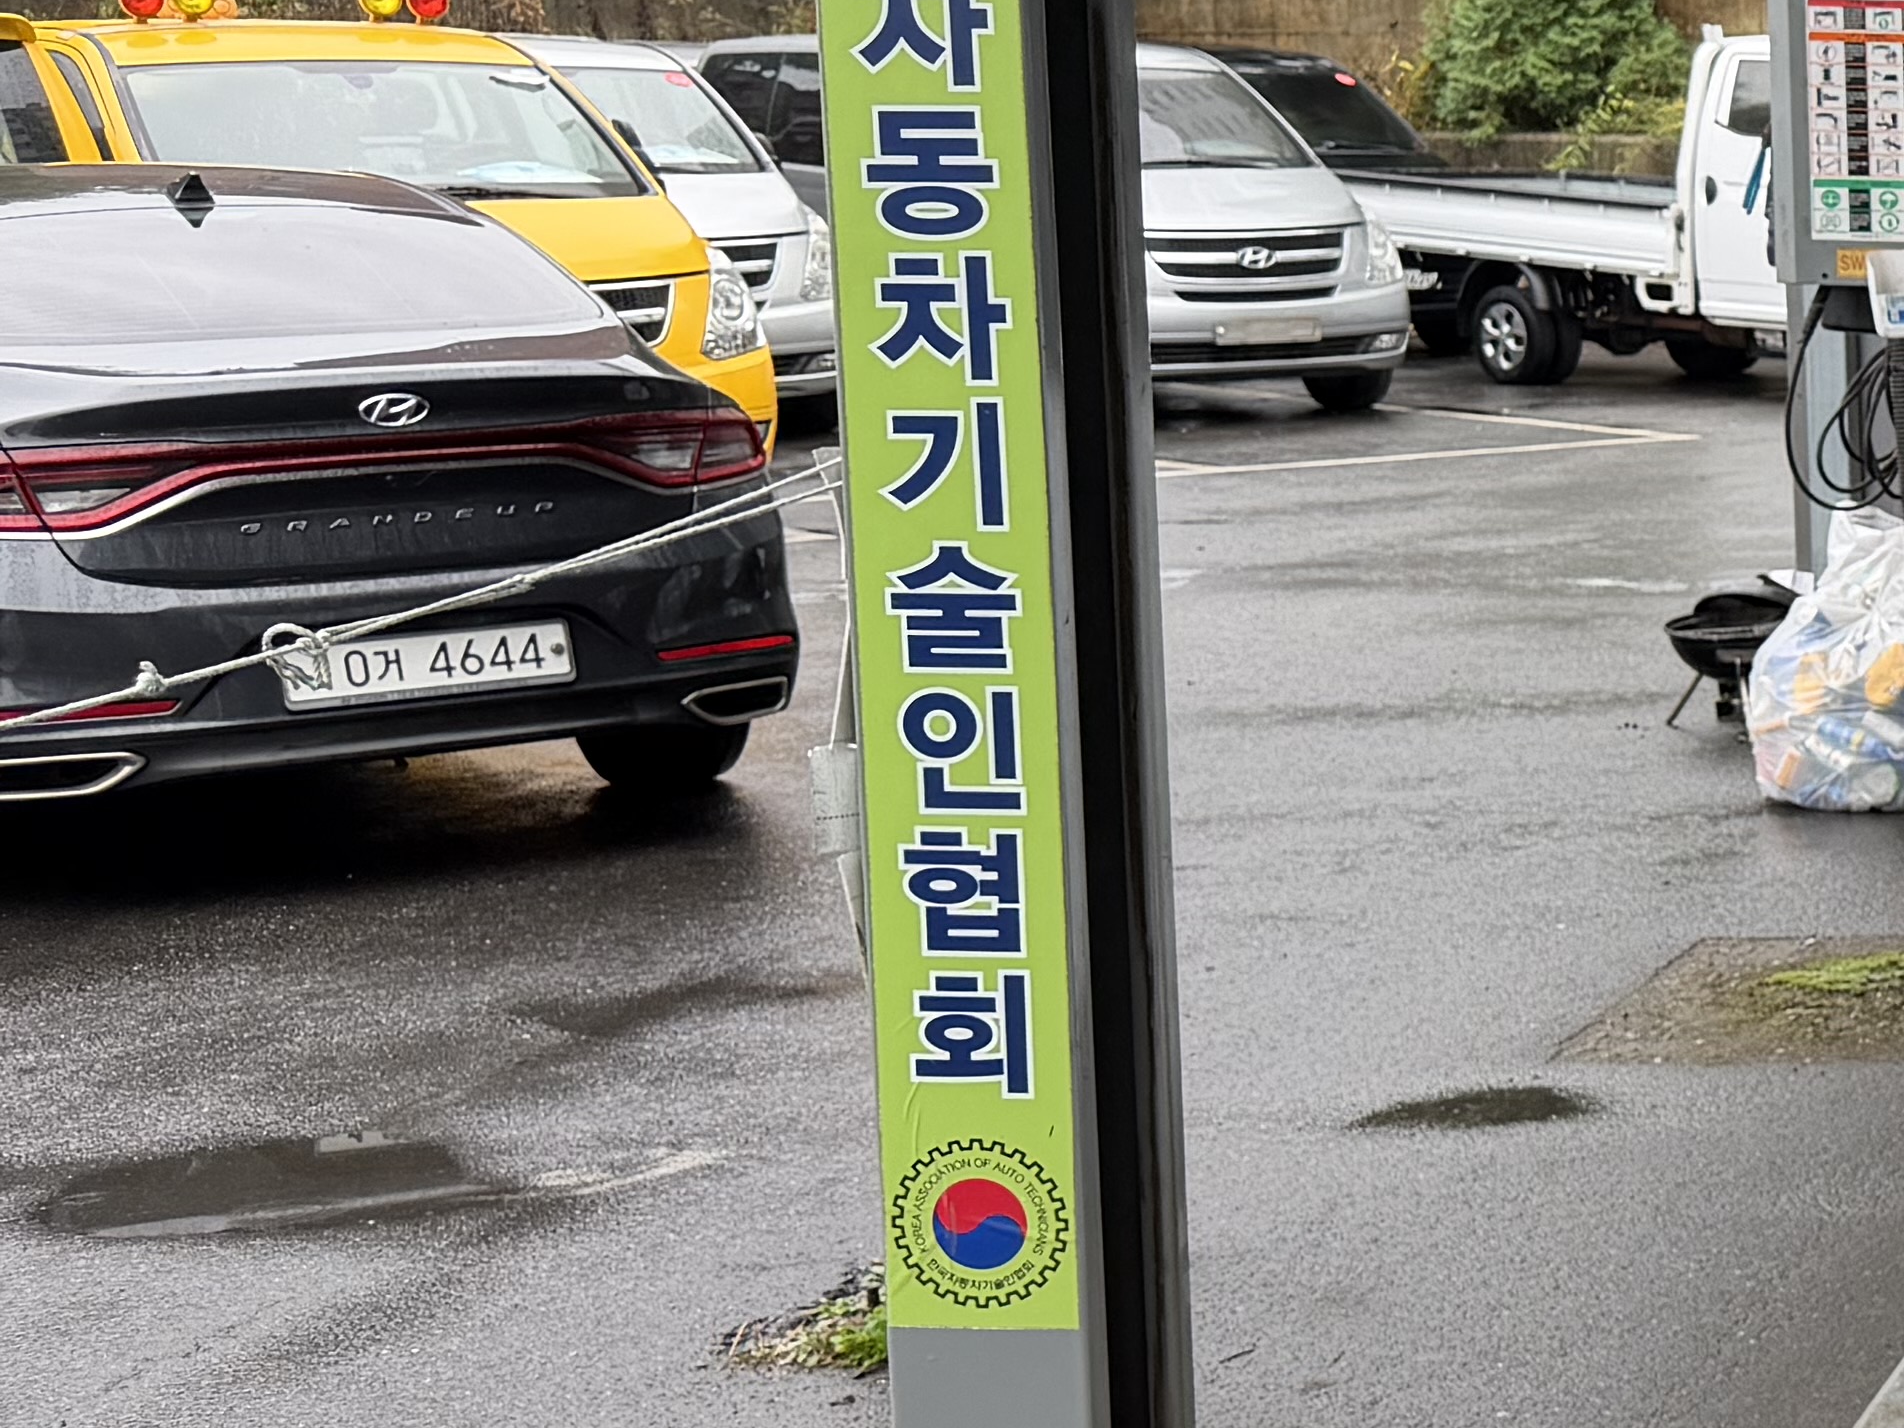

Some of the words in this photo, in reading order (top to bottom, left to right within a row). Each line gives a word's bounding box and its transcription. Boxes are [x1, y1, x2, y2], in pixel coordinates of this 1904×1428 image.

[240, 502, 553, 535] GRANDEUR
[320, 649, 404, 687] 0거
[429, 633, 545, 678] 4644
[973, 1158, 991, 1168] OF
[993, 1161, 1025, 1184] AUTO
[913, 1158, 971, 1211] ASSOCIATION
[911, 1214, 930, 1255] KOREA
[1023, 1181, 1049, 1256] TECHNICIANS
